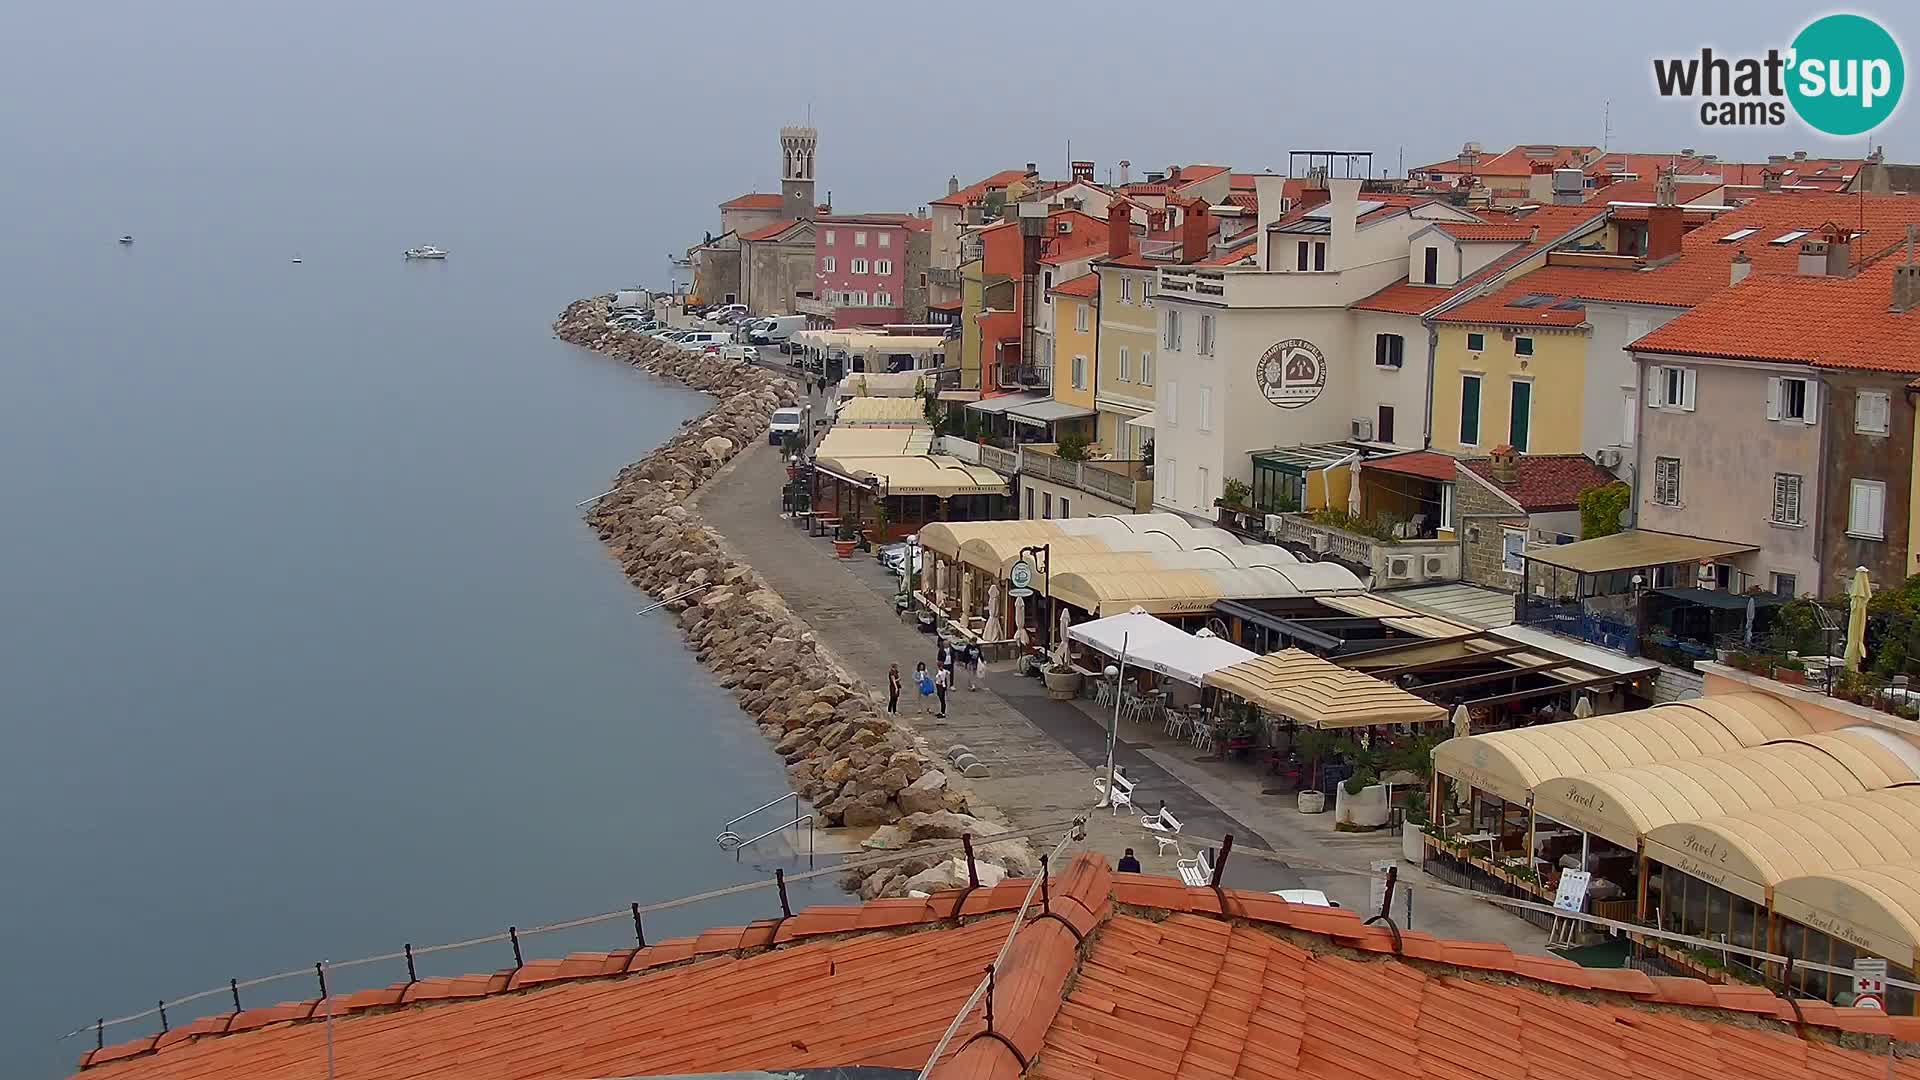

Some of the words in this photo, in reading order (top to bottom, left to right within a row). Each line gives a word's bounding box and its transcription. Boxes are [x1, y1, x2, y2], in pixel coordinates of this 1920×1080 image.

[1257, 345, 1279, 386] RESTAURANT
[1566, 784, 1596, 808] Pavel
[1598, 800, 1605, 812] 2
[1683, 832, 1717, 857] Pavel
[1720, 848, 1728, 863] 2
[1677, 856, 1726, 885] Restaurant
[1805, 912, 1834, 930] Pavel
[1833, 925, 1841, 934] 2
[1842, 927, 1873, 947] Piran
